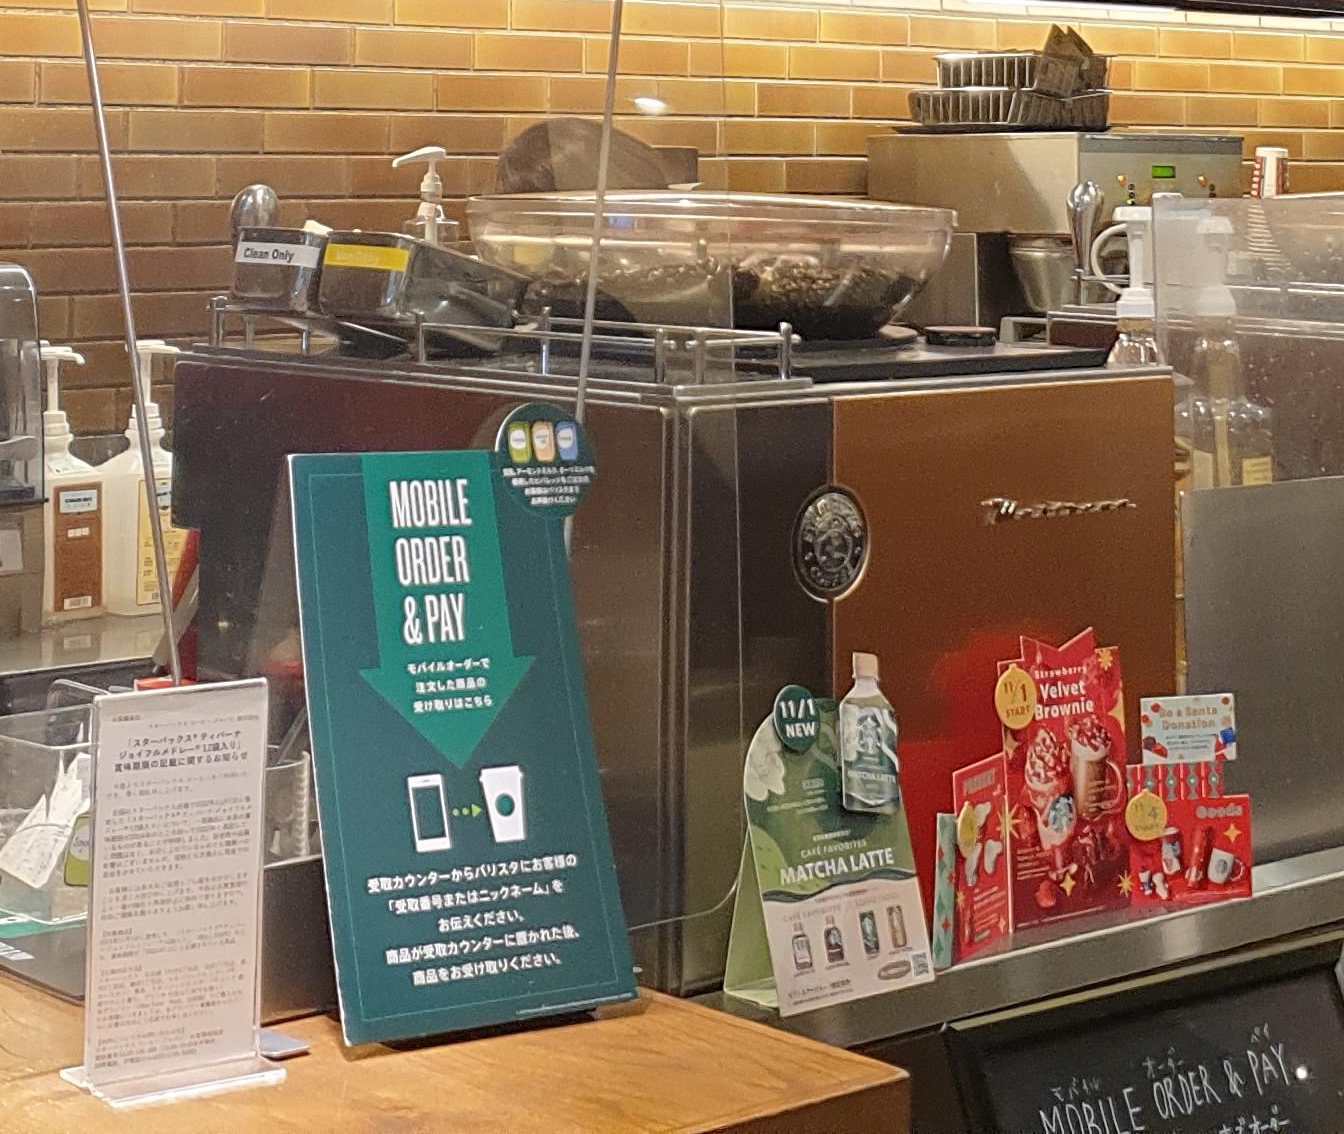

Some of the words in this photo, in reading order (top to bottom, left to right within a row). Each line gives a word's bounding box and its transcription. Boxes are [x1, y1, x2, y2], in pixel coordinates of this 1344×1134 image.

[243, 247, 269, 260] Clean
[272, 248, 294, 263] Only
[389, 478, 473, 528] MOBILE
[395, 535, 470, 586] ORDER
[403, 596, 423, 644] &
[424, 593, 465, 642] PAY
[406, 658, 490, 676] モバイルオーダーで
[1035, 666, 1087, 679] Strawberry
[415, 677, 486, 694] 注文した商品の
[1040, 680, 1086, 703] Velvet
[413, 694, 492, 714] 受け取りはこちら
[779, 698, 816, 719] 11/1
[1006, 706, 1030, 718] START
[1035, 697, 1094, 720] Brownie
[1185, 706, 1218, 717] Santa
[785, 722, 817, 739] NEW
[1162, 718, 1216, 730] Donation
[823, 839, 867, 853] FAVORITES
[367, 854, 577, 894] 受取カウンターからバリスタにお客様の
[780, 857, 848, 885] MATCHA
[850, 848, 895, 872] LATTE
[388, 880, 564, 914] 「受取番号またはニックネーム」を
[438, 910, 525, 933] お伝えください。
[385, 926, 580, 965] 商品が受取カウンターに置かれた後、
[412, 954, 561, 986] 商品をお受け取りください。
[1039, 1087, 1145, 1134] MOBILE
[1153, 1064, 1222, 1119] ORDER
[1224, 1060, 1244, 1098] &
[1247, 1043, 1290, 1095] PAY
